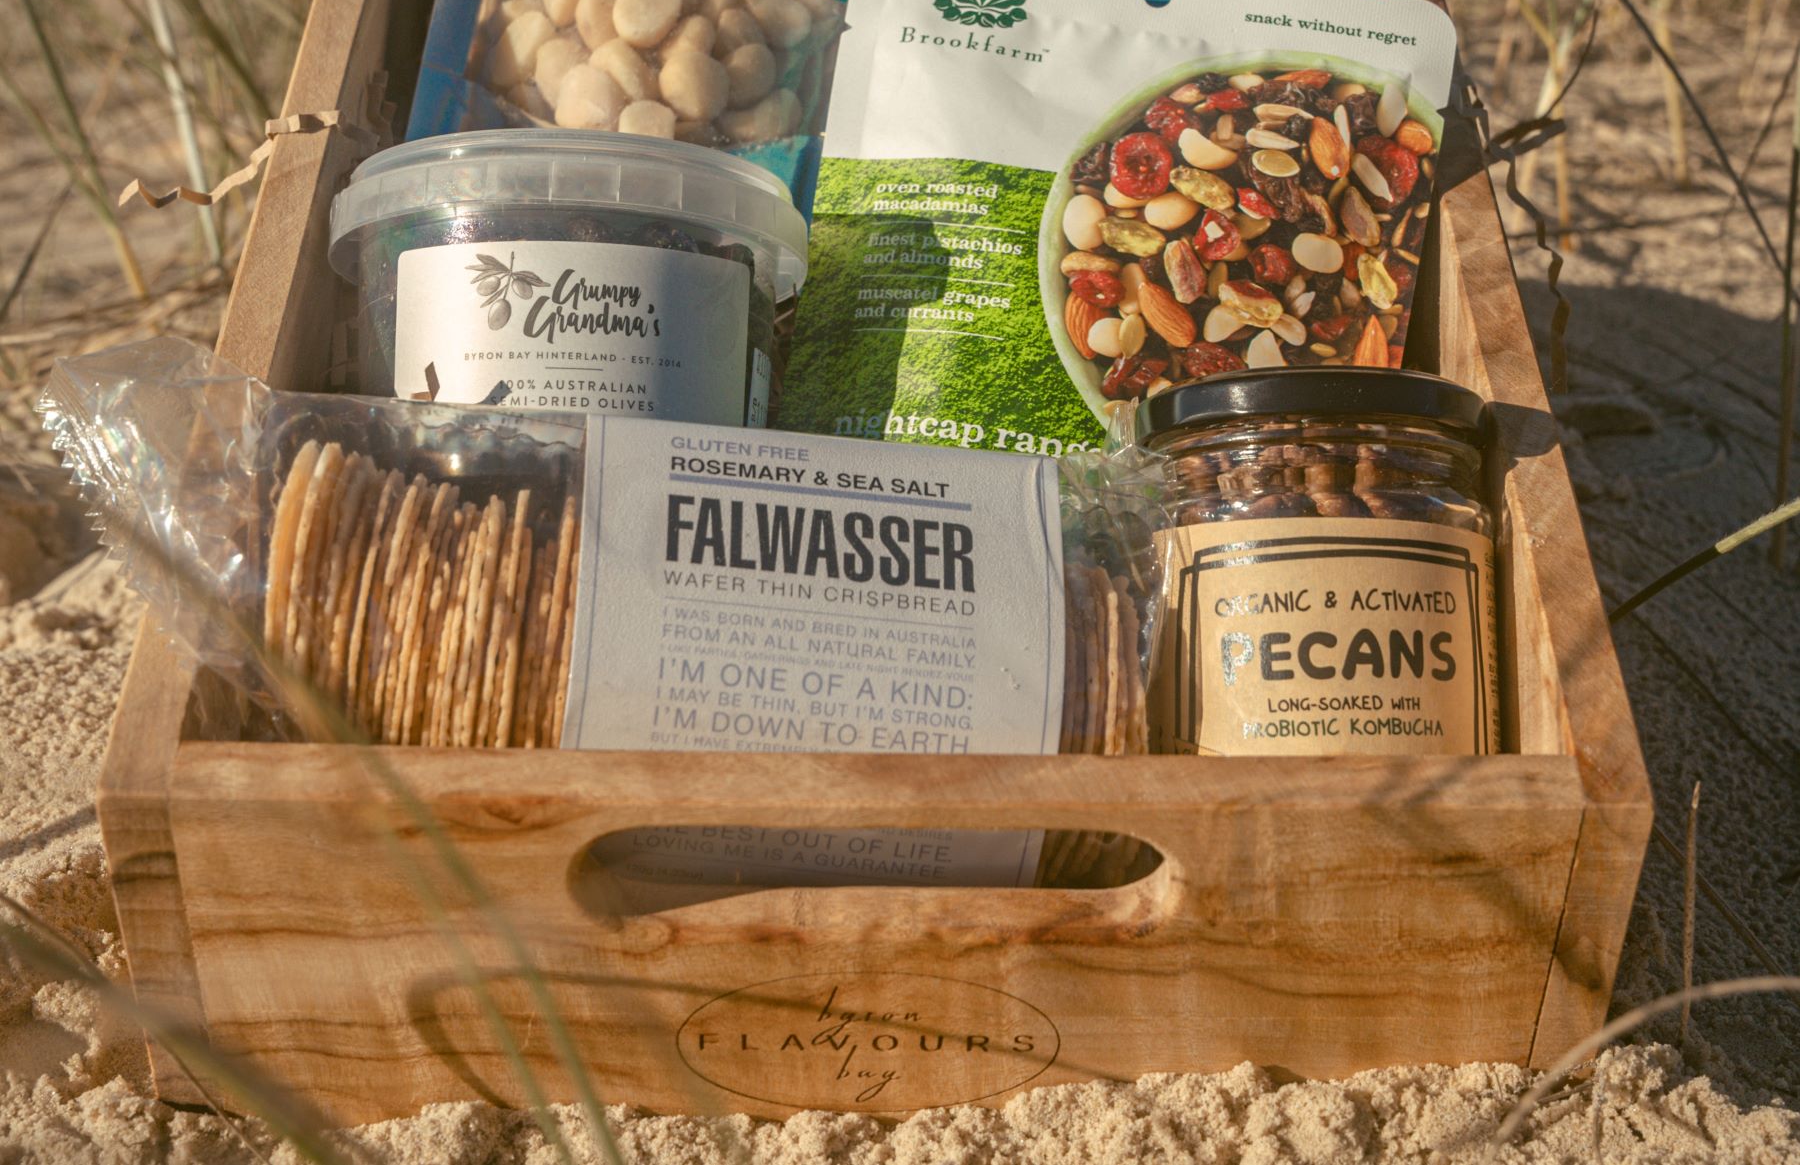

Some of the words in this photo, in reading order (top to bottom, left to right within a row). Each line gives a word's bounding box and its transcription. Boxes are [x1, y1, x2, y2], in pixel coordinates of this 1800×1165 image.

[1244, 10, 1293, 30] snack
[1296, 16, 1363, 41] without
[1367, 27, 1417, 47] regret
[873, 197, 989, 215] macadamias
[876, 182, 920, 194] oven
[926, 181, 999, 199] roasted
[863, 251, 896, 265] and
[901, 251, 984, 270] almonds
[867, 232, 918, 246] finest
[923, 233, 1023, 255] pistachios
[552, 269, 641, 310] Grumpy
[858, 287, 939, 302] muscatel
[942, 290, 1011, 309] grapes
[523, 294, 661, 345] Grandma's
[855, 304, 885, 319] and
[890, 306, 975, 322] currants
[464, 351, 503, 362] BYRON
[509, 351, 531, 362] BAY
[536, 350, 617, 363] HINTERLAND
[631, 355, 656, 366] EST.
[658, 358, 682, 369] 2014
[490, 396, 591, 409] SEMI-DRIED
[598, 398, 655, 412] OLIVES
[543, 379, 647, 395] AUSTRALIAN
[835, 408, 984, 447] nightcap
[670, 435, 752, 456] GLUTEN
[758, 444, 810, 462] FREE
[670, 455, 806, 483] ROSEMARY
[813, 470, 828, 486] &
[836, 472, 884, 492] SEA
[891, 478, 950, 498] SALT
[665, 494, 976, 593] FALWASSER
[664, 569, 746, 593] WAFER
[757, 579, 812, 600] THIN
[824, 586, 976, 616] CRISPBREAD
[1214, 589, 1312, 618] ORGANIC
[1325, 590, 1338, 609] &
[1351, 588, 1457, 615] ACTIVATED
[674, 608, 711, 623] WAS
[718, 611, 765, 628] BORN
[771, 617, 806, 632] AND
[812, 621, 857, 638] BRED
[864, 627, 880, 640] IN
[886, 628, 977, 650] AUSTRALIA
[662, 623, 720, 643] FROM
[727, 630, 756, 646] AN
[764, 634, 800, 652] ALL
[808, 638, 898, 662] NATURAL
[907, 648, 976, 670] FAMILY.
[1220, 628, 1457, 686] PECANS
[658, 656, 706, 684] I'M
[719, 662, 788, 693] ONE
[801, 670, 844, 697] OF
[856, 677, 876, 701] A
[890, 679, 974, 711] KIND:
[668, 687, 711, 705] MAY
[718, 690, 742, 707] BE
[810, 701, 848, 718] BUT
[855, 704, 883, 721] I'M
[1268, 695, 1384, 713] LONG-SOAKED
[1391, 696, 1421, 711] WITH
[652, 705, 698, 731] I'M
[711, 711, 806, 742] DOWN
[819, 721, 858, 747] TO
[870, 727, 970, 754] EARTH
[1243, 718, 1340, 740] PROBIOTIC
[1350, 718, 1444, 737] KOMBUCHA
[632, 835, 715, 855] LOVING
[724, 844, 752, 858] ME
[764, 847, 784, 860] IS
[791, 849, 806, 863] A
[814, 852, 946, 879] GUARANTEE
[781, 829, 841, 851] OUT
[848, 836, 884, 856] OF
[894, 841, 952, 863] LIFE.
[816, 985, 923, 1045] byron
[699, 1034, 1036, 1053] FLAVOURS
[834, 1042, 902, 1103] bay
